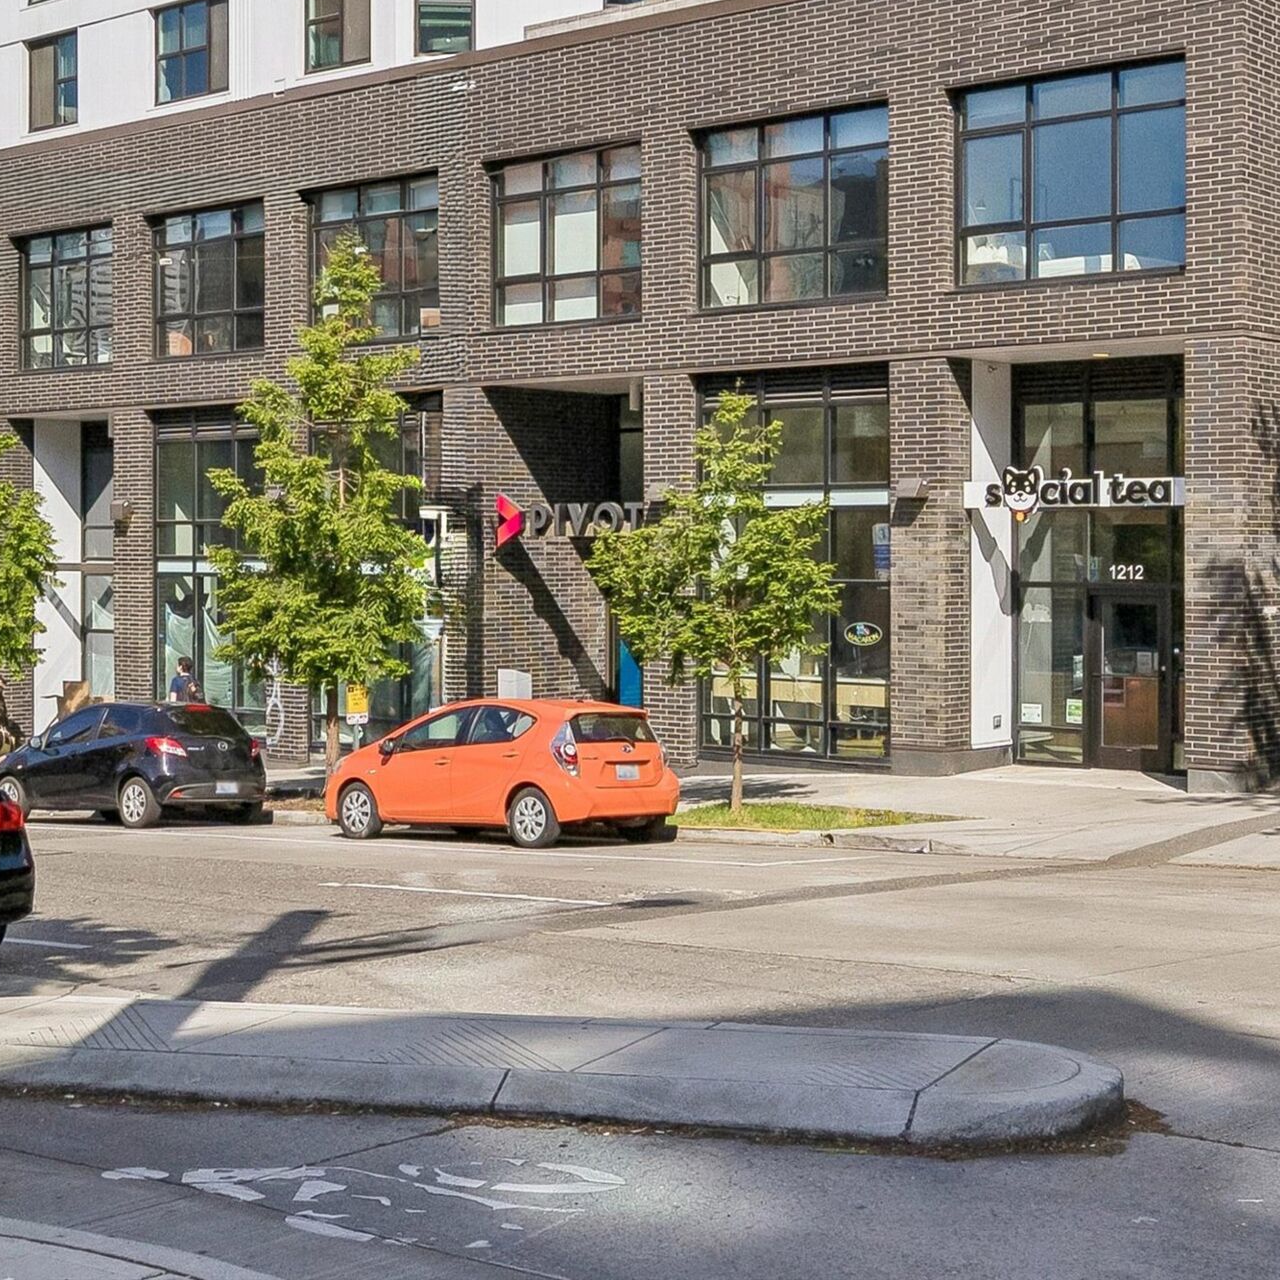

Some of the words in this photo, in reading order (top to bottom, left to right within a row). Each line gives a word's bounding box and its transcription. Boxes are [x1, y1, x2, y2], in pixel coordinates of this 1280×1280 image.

[985, 469, 1101, 506] scial
[1109, 475, 1173, 505] tea
[530, 502, 643, 536] PIVOT
[1109, 565, 1144, 580] 1212
